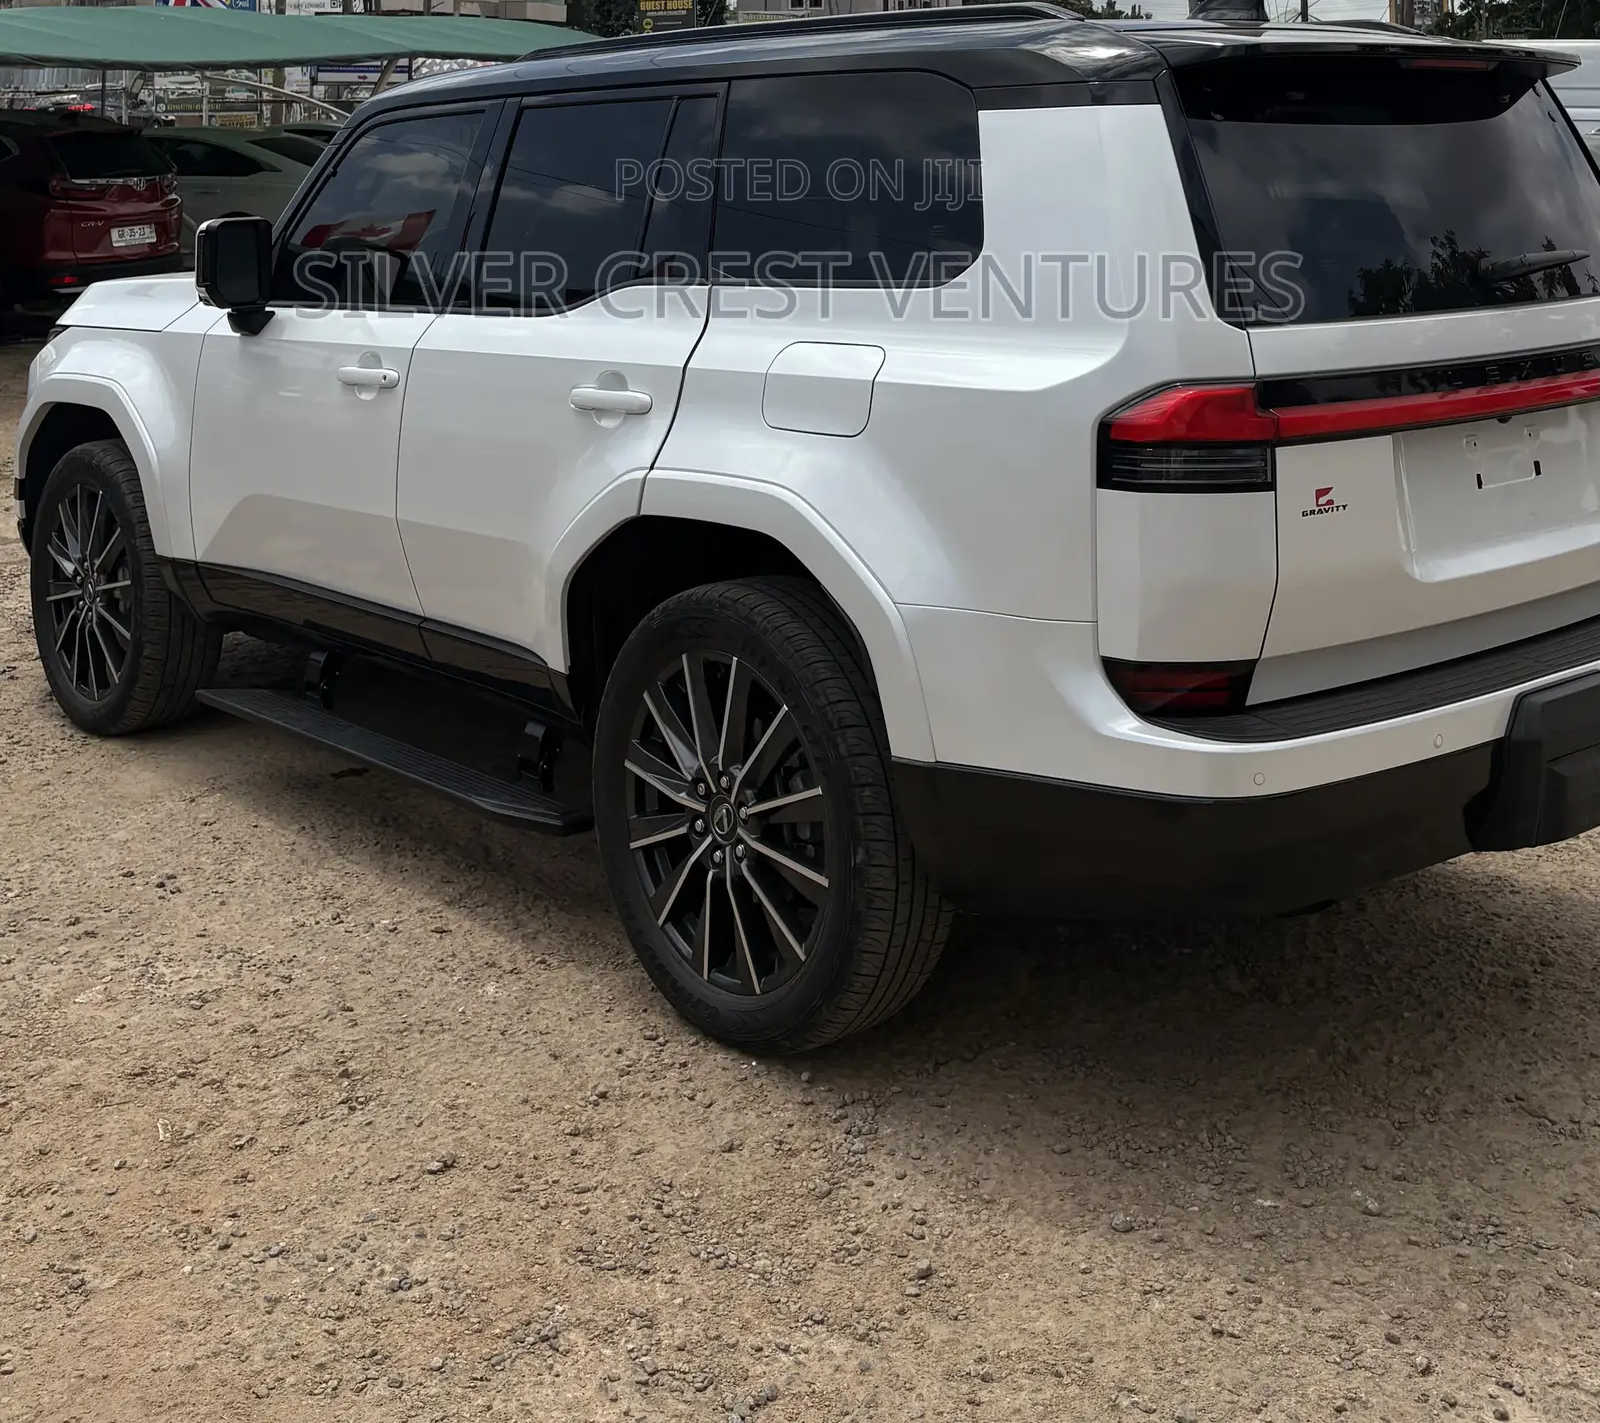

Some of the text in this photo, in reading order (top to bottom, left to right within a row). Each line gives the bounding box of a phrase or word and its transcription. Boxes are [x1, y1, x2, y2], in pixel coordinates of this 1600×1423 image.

[640, 0, 693, 10] GUEST HOUSE
[1302, 504, 1348, 517] GRAVITY
